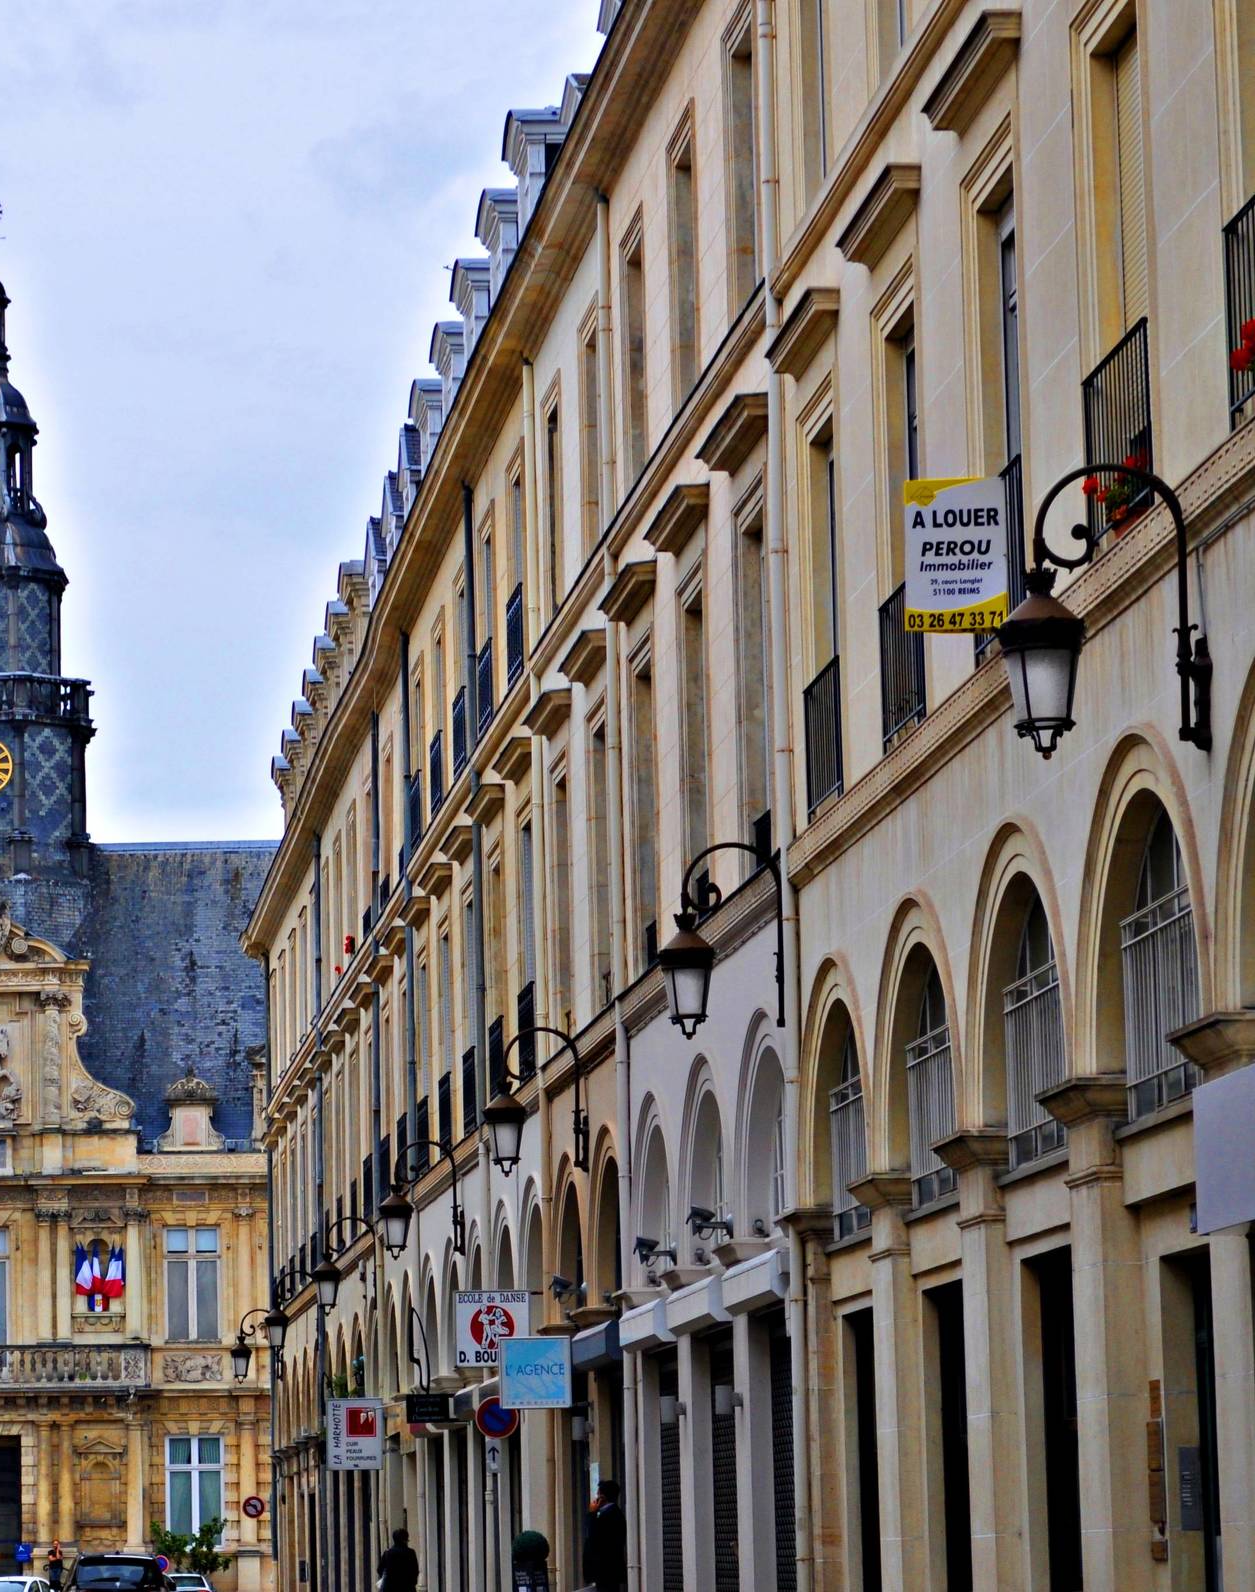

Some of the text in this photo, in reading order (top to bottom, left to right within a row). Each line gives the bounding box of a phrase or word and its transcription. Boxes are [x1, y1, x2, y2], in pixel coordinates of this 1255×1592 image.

[912, 507, 1000, 529] A LOUER
[920, 539, 992, 557] PEROU
[919, 559, 993, 572] Immobilier
[932, 586, 981, 596] 51100 REIMS
[908, 611, 1004, 629] 03 26 47 33 71
[458, 1293, 527, 1304] ECOLE de DANSE
[459, 1351, 497, 1363] D. BOU
[516, 1363, 565, 1376] AGENCE
[333, 1454, 342, 1465] LA
